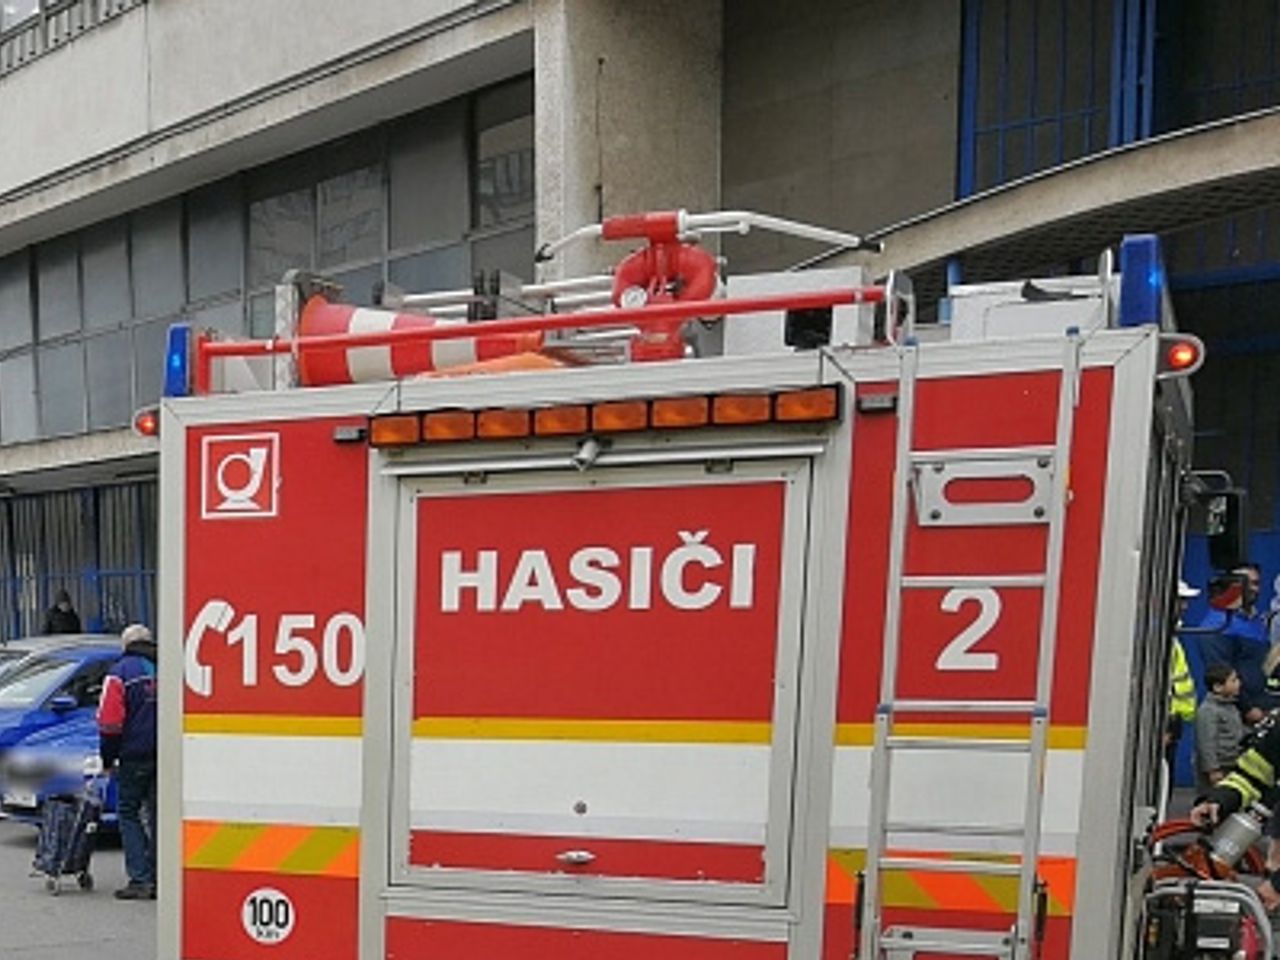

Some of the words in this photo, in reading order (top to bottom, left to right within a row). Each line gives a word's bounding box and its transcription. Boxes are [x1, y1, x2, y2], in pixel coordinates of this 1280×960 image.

[440, 530, 756, 612] HASIČI
[227, 612, 366, 686] 150
[935, 587, 1002, 670] 2
[248, 896, 290, 929] 100
